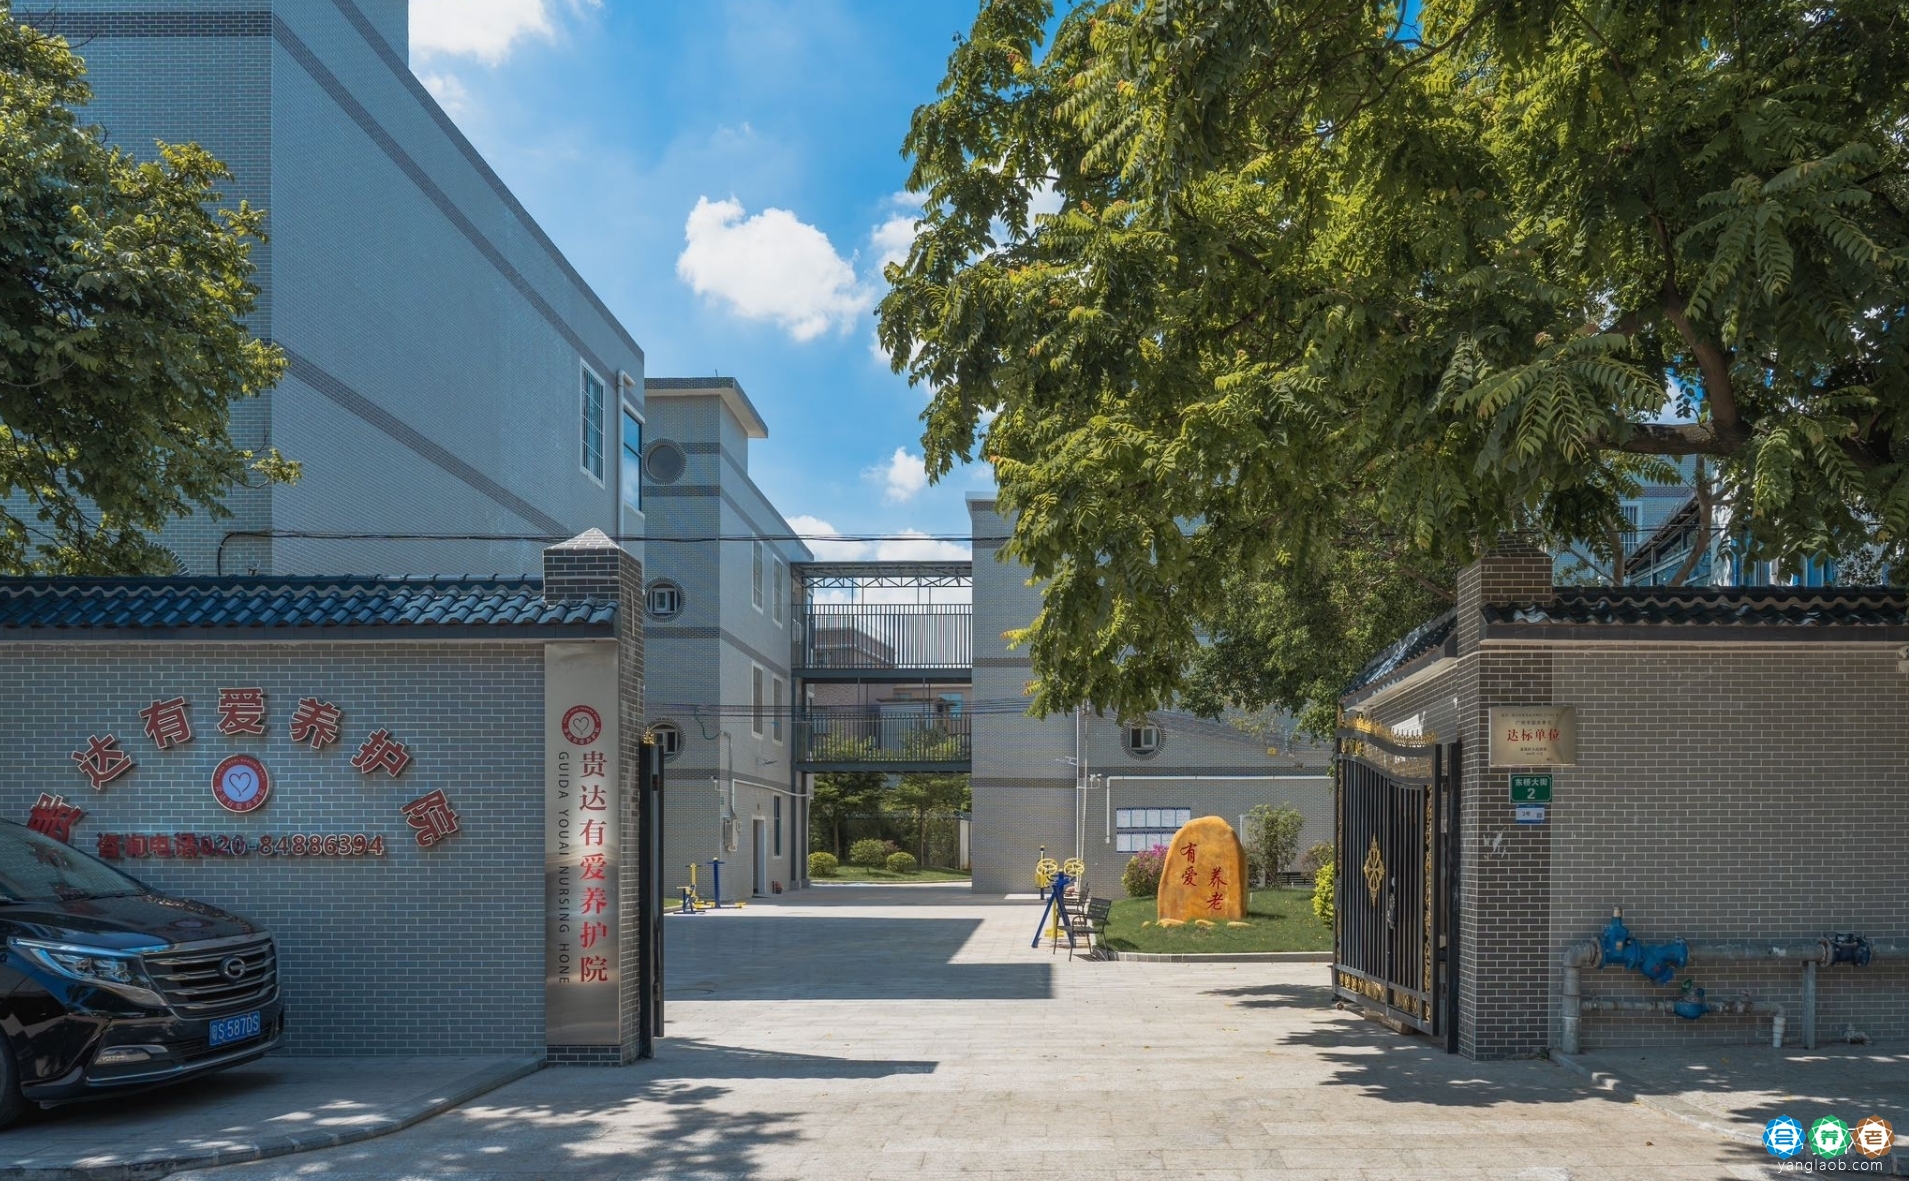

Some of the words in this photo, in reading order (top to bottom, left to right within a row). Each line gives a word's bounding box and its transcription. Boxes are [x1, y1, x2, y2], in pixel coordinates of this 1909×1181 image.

[1507, 729, 1560, 742] 达标单位
[27, 687, 459, 848] 贵达有爱养护院
[558, 751, 569, 799] GUIDA
[1515, 778, 1548, 787] 东桥大街
[1527, 788, 1536, 800] 2
[96, 833, 384, 858] 咨询电话020-84886394
[558, 810, 569, 855] YOUAI
[579, 750, 608, 983] 贵达有爱养护院
[1180, 842, 1198, 887] 有爱
[558, 866, 569, 933] NURSING
[1206, 866, 1228, 911] 养老
